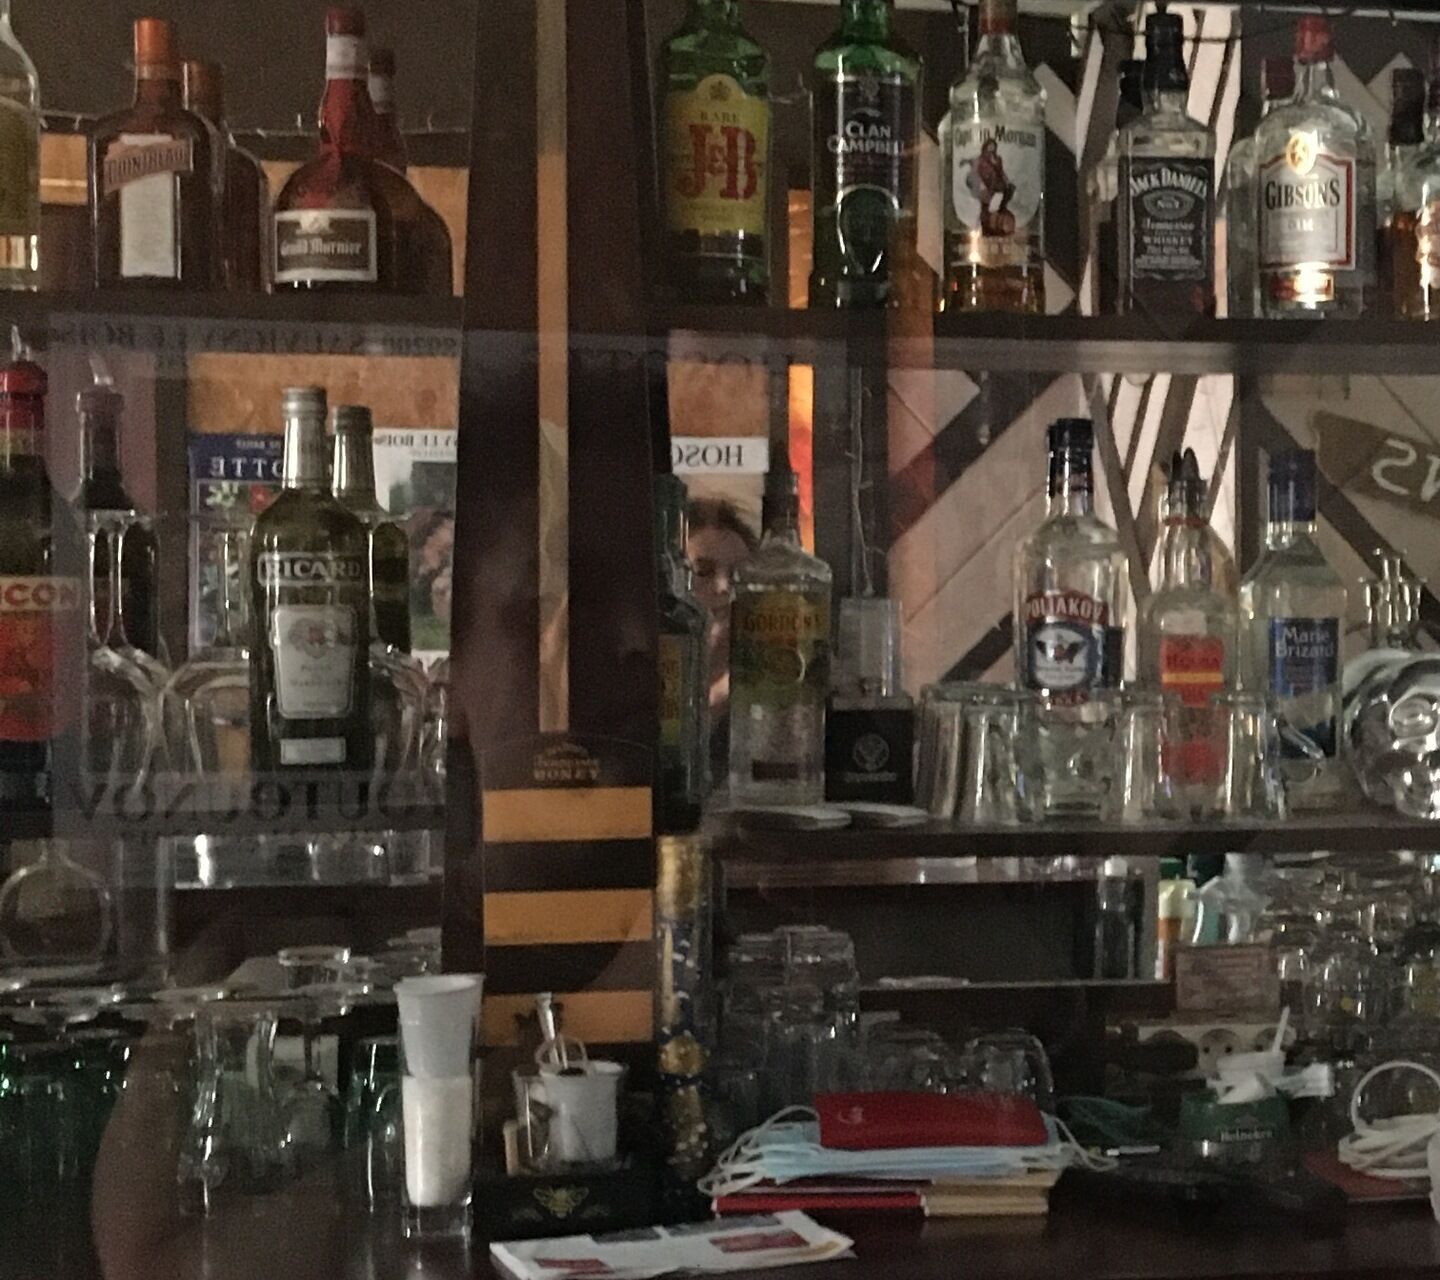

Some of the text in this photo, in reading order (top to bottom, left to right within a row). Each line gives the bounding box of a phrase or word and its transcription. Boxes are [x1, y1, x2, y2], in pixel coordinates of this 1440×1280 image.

[845, 120, 892, 139] CLAN
[675, 123, 759, 202] J&B
[264, 558, 361, 579] RICARD
[0, 582, 79, 609] CON
[1282, 626, 1330, 644] Marie
[1275, 640, 1335, 659] Brizard
